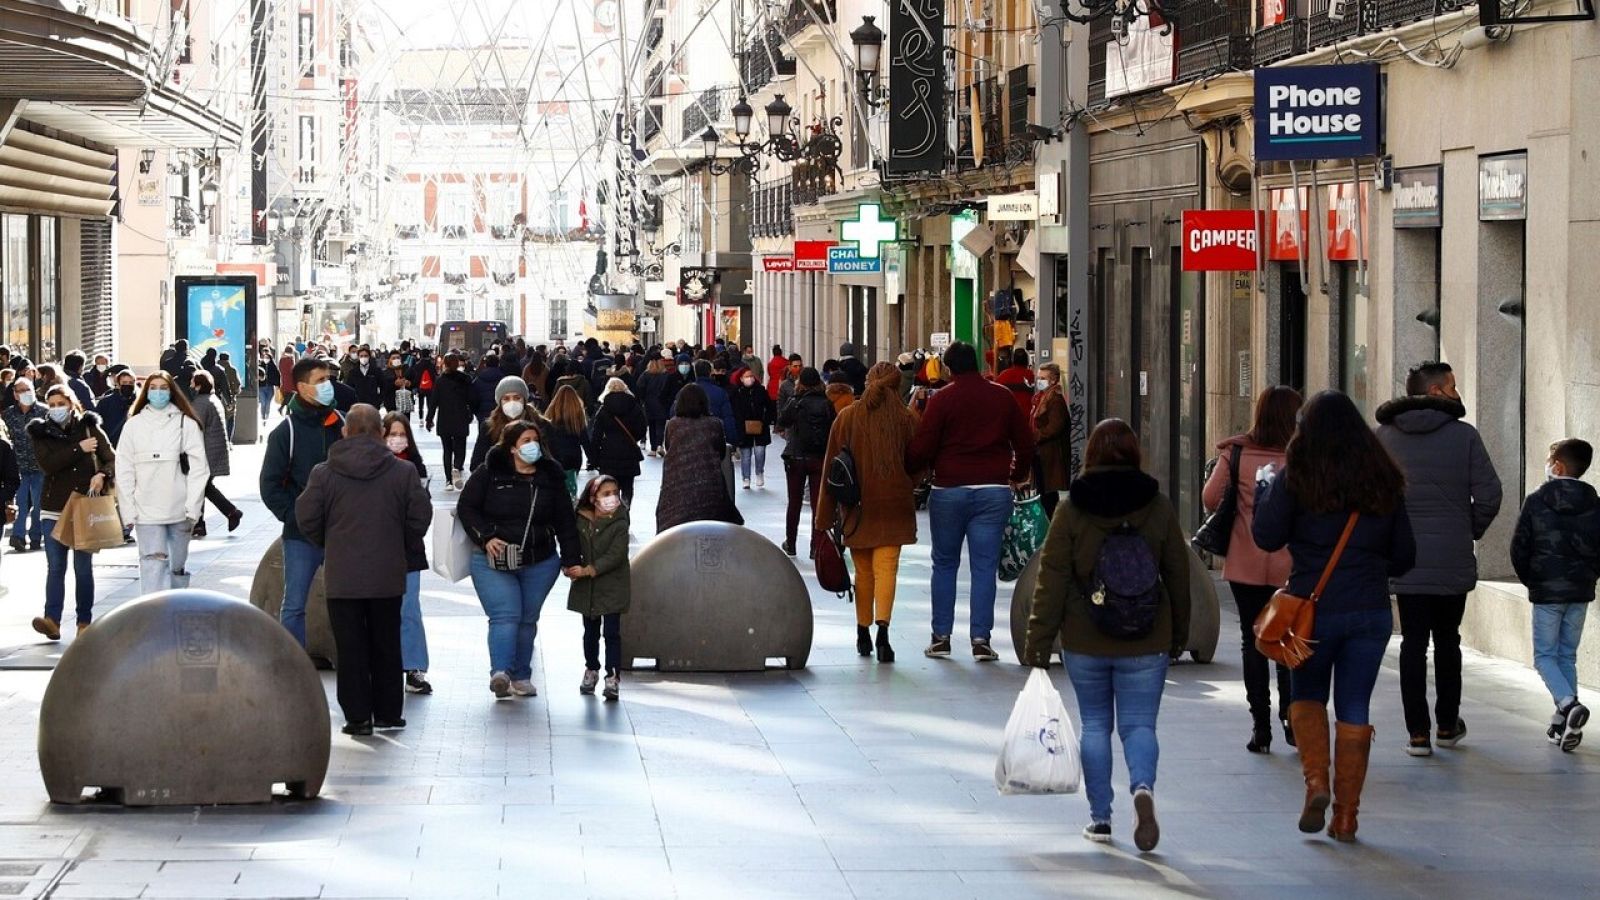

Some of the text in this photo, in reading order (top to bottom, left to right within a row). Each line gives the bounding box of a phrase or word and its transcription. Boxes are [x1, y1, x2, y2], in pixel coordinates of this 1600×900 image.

[1269, 84, 1361, 109] Phone
[1269, 112, 1361, 136] House
[1190, 229, 1256, 254] CAMPER
[834, 261, 876, 271] MONEY
